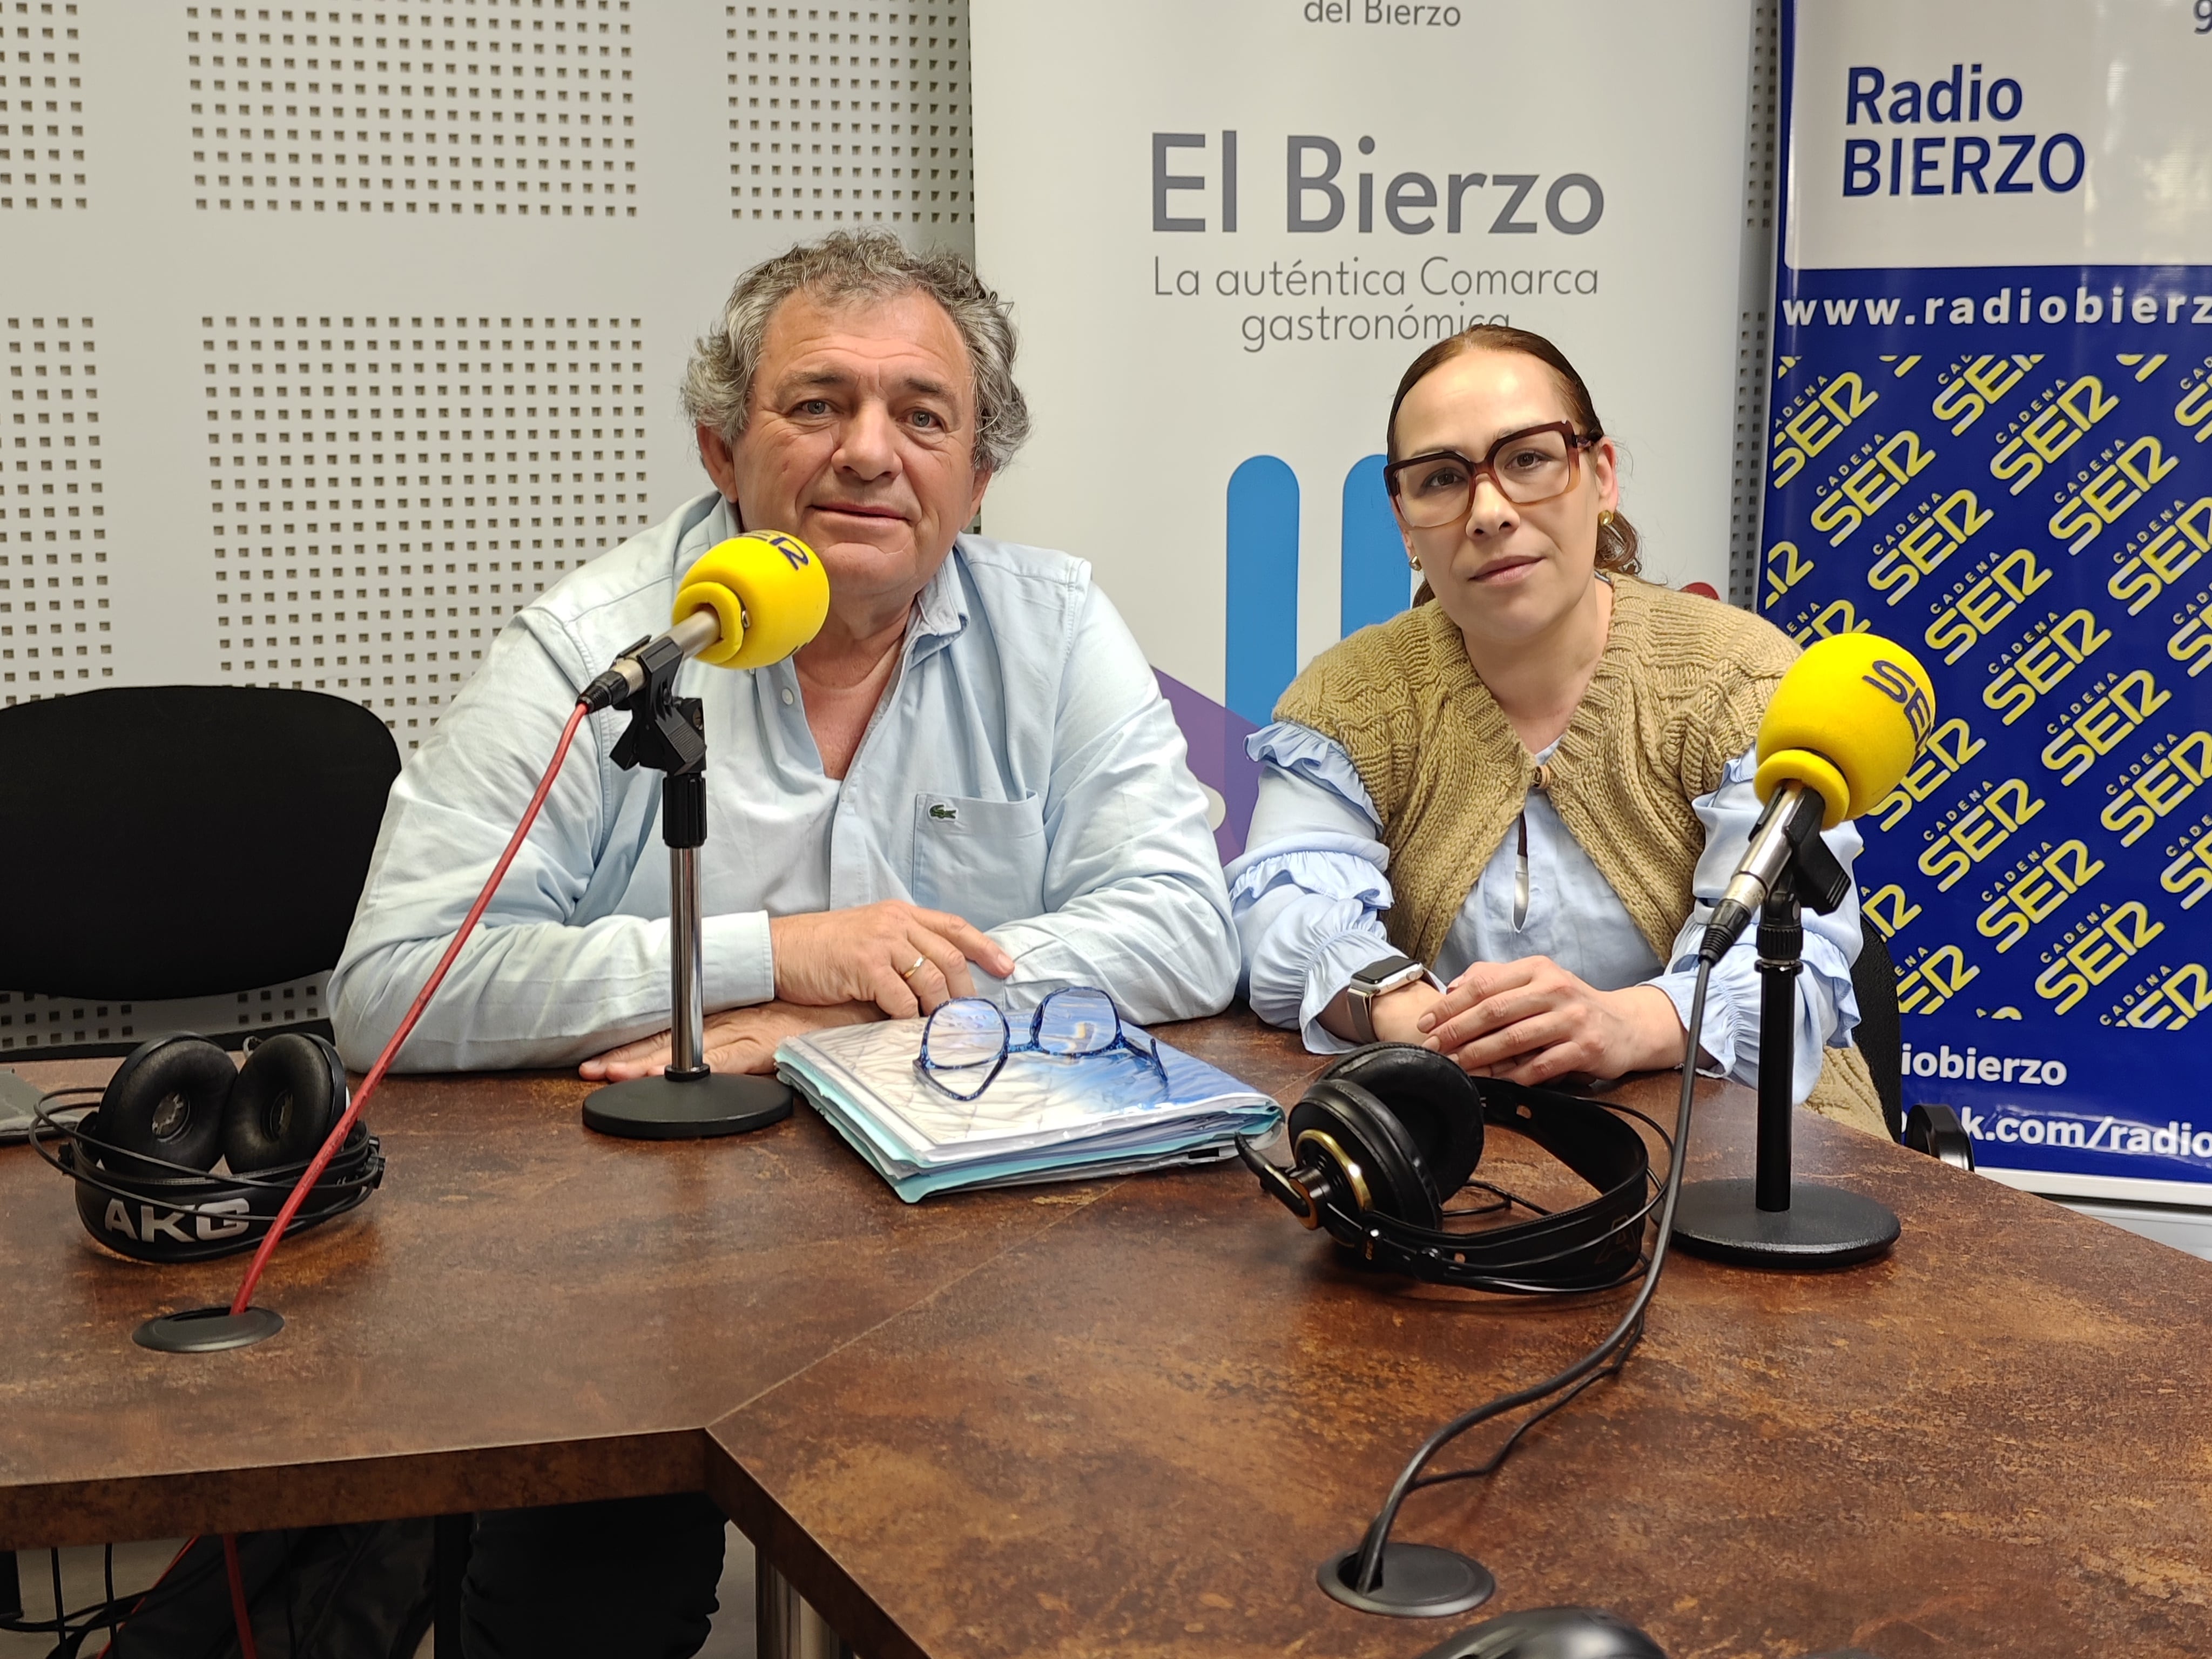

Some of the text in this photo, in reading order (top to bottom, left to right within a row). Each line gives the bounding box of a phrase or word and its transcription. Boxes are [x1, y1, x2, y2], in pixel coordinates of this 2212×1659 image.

[1304, 0, 1461, 27] del Bierzo
[1846, 63, 2023, 126] Radio
[1151, 130, 1604, 235] El Bierzo
[1842, 132, 2086, 198] BIERZO
[1155, 255, 1598, 296] La auténtica Comarca
[1775, 376, 1827, 428] ADENA
[1932, 354, 2045, 437] SE
[1995, 380, 2067, 444] CADENA
[1816, 434, 1885, 496] CADENA
[1990, 375, 2119, 496] SER
[1811, 430, 1936, 548] SER
[2048, 436, 2179, 556] SER
[2054, 440, 2125, 503] CADENA
[1867, 489, 1994, 606] SER
[1873, 493, 1942, 555] CADENA
[2113, 500, 2186, 564] CADENA
[1925, 549, 2053, 666] SER
[1930, 552, 2000, 614] CADENA
[1982, 609, 2112, 726] SER
[1988, 612, 2059, 674] CADENA
[2041, 670, 2172, 786] SER
[2047, 673, 2118, 734] CADENA
[2106, 734, 2179, 795] CADENA
[1918, 778, 2046, 893] SER
[1923, 781, 1993, 841] CADENA
[1976, 839, 2105, 954] SER
[1981, 842, 2052, 902] CADENA
[2034, 901, 2165, 1016] SER
[2040, 903, 2111, 963] CADENA
[1896, 945, 1980, 1015] ER
[2099, 966, 2171, 1026] CADENA
[2115, 963, 2212, 1030] ER
[1901, 1106, 2212, 1158] k.com/radio
[104, 1197, 250, 1242] AKG
